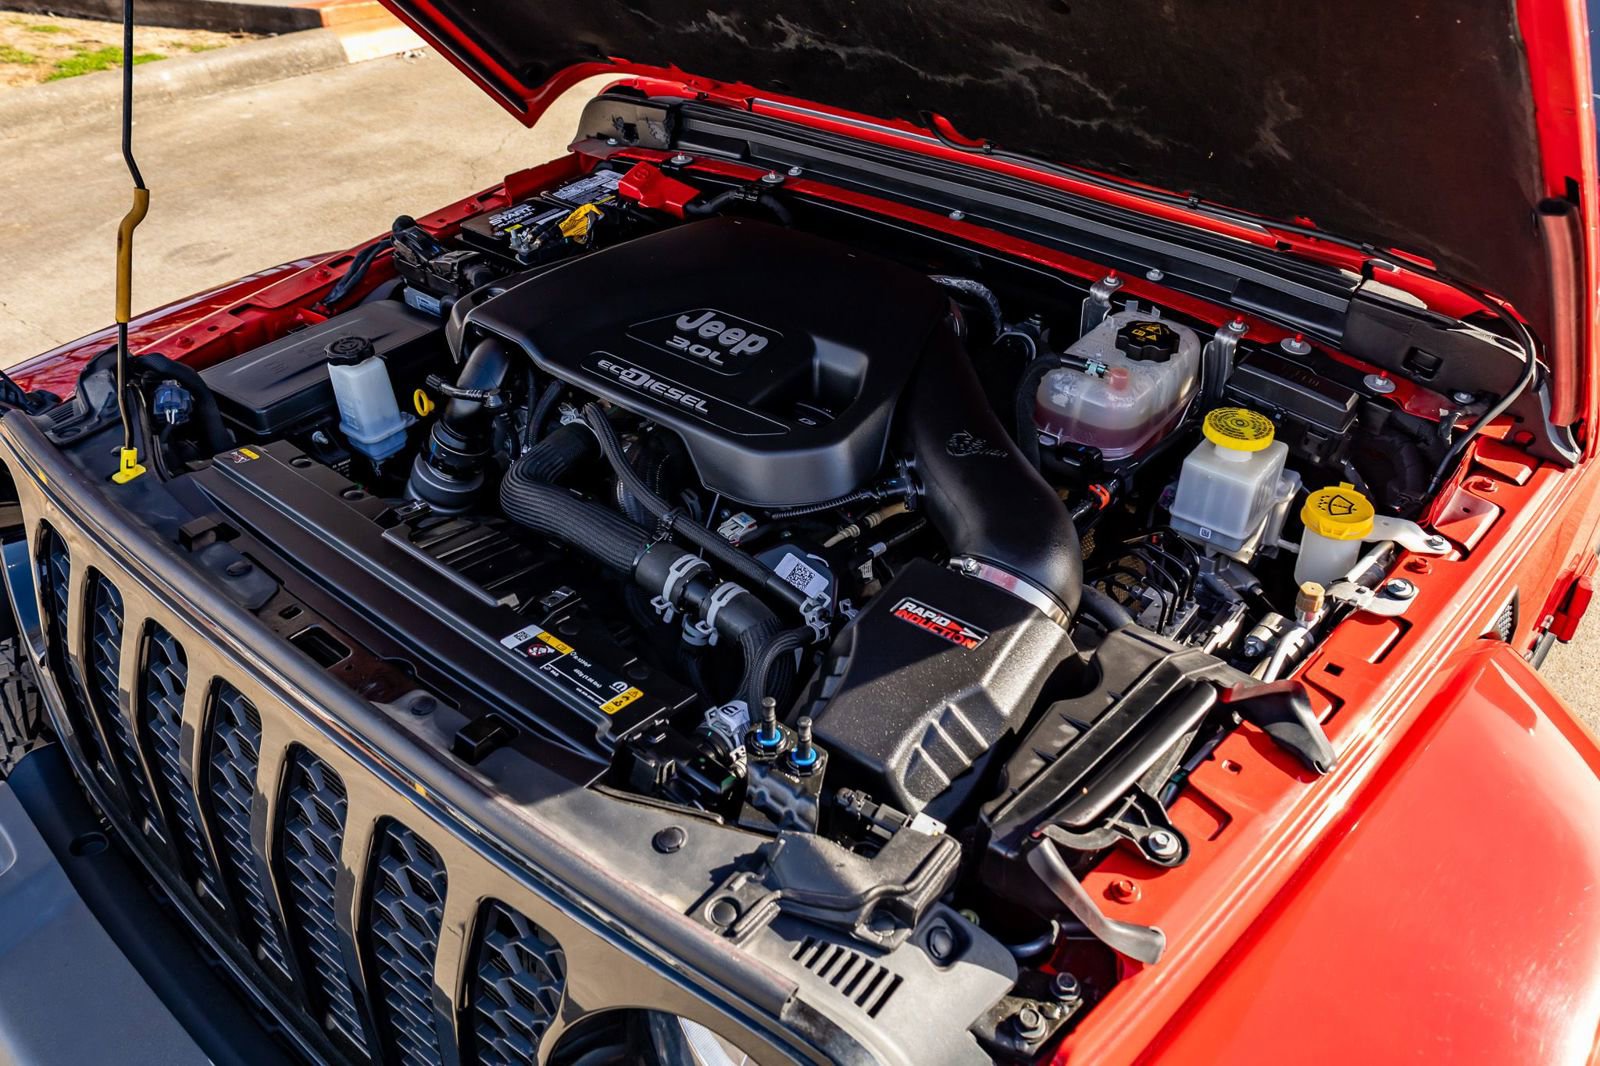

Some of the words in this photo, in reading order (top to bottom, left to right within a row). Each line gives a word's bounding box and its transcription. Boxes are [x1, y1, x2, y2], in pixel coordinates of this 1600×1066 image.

[666, 336, 724, 366] 3.0L
[676, 312, 768, 355] Jeep
[895, 610, 978, 650] INDUCTION
